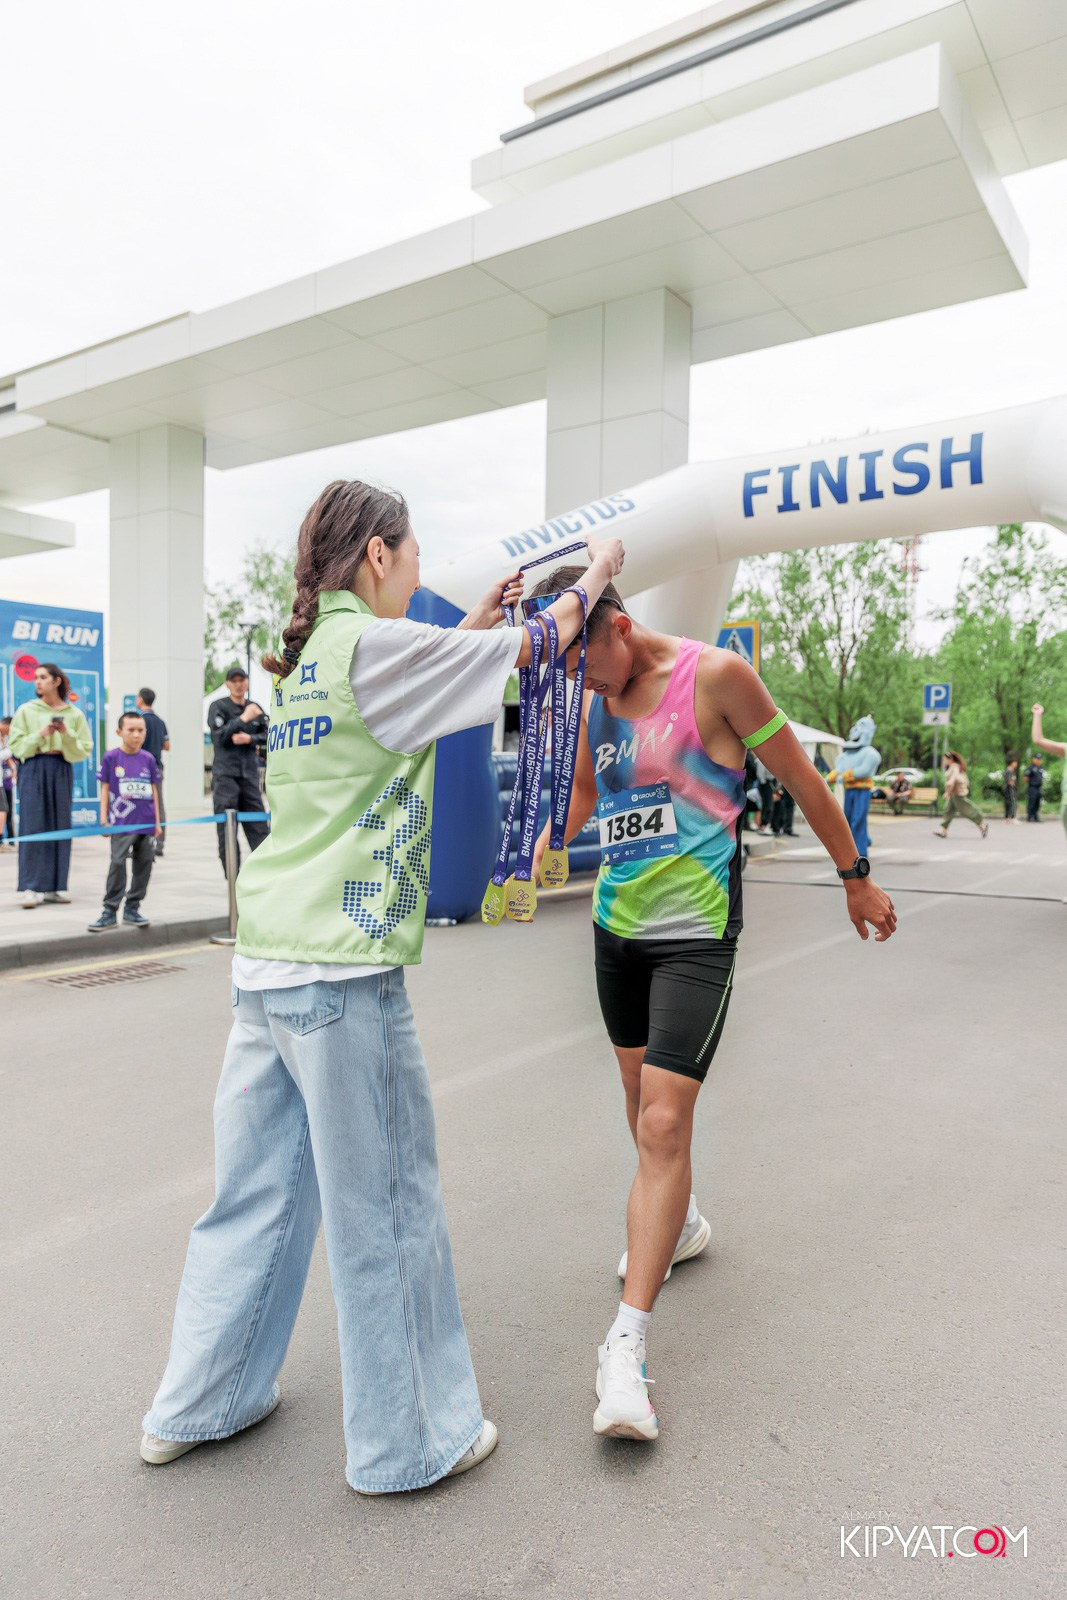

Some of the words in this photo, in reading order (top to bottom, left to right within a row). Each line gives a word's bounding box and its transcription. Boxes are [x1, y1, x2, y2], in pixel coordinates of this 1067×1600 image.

[742, 432, 984, 518] FINISH
[500, 492, 635, 557] INVICTUS
[12, 620, 41, 641] BI
[46, 623, 100, 648] RUN
[533, 646, 541, 673] Dream
[290, 692, 310, 703] Arena
[311, 689, 329, 701] City
[555, 668, 564, 707] ВМЕСТЕ
[568, 671, 583, 733] ПЕРЕМЕНАМ
[929, 685, 947, 702] P
[267, 715, 333, 753] ОНТЕР
[554, 717, 564, 763] ДОБРЫМ
[562, 735, 575, 778] ДОБРЫМ
[510, 768, 521, 815] ДОБРЫМ
[529, 762, 542, 809] ДОБРЫМ
[560, 778, 569, 787] К
[639, 791, 657, 799] GROUP
[508, 814, 514, 823] К
[527, 808, 536, 817] К
[555, 787, 568, 826] ВМЕСТЕ
[600, 802, 605, 811] 5
[499, 825, 511, 863] ВМЕСТЕ
[521, 817, 535, 858] ВМЕСТЕ
[607, 808, 664, 844] 1384
